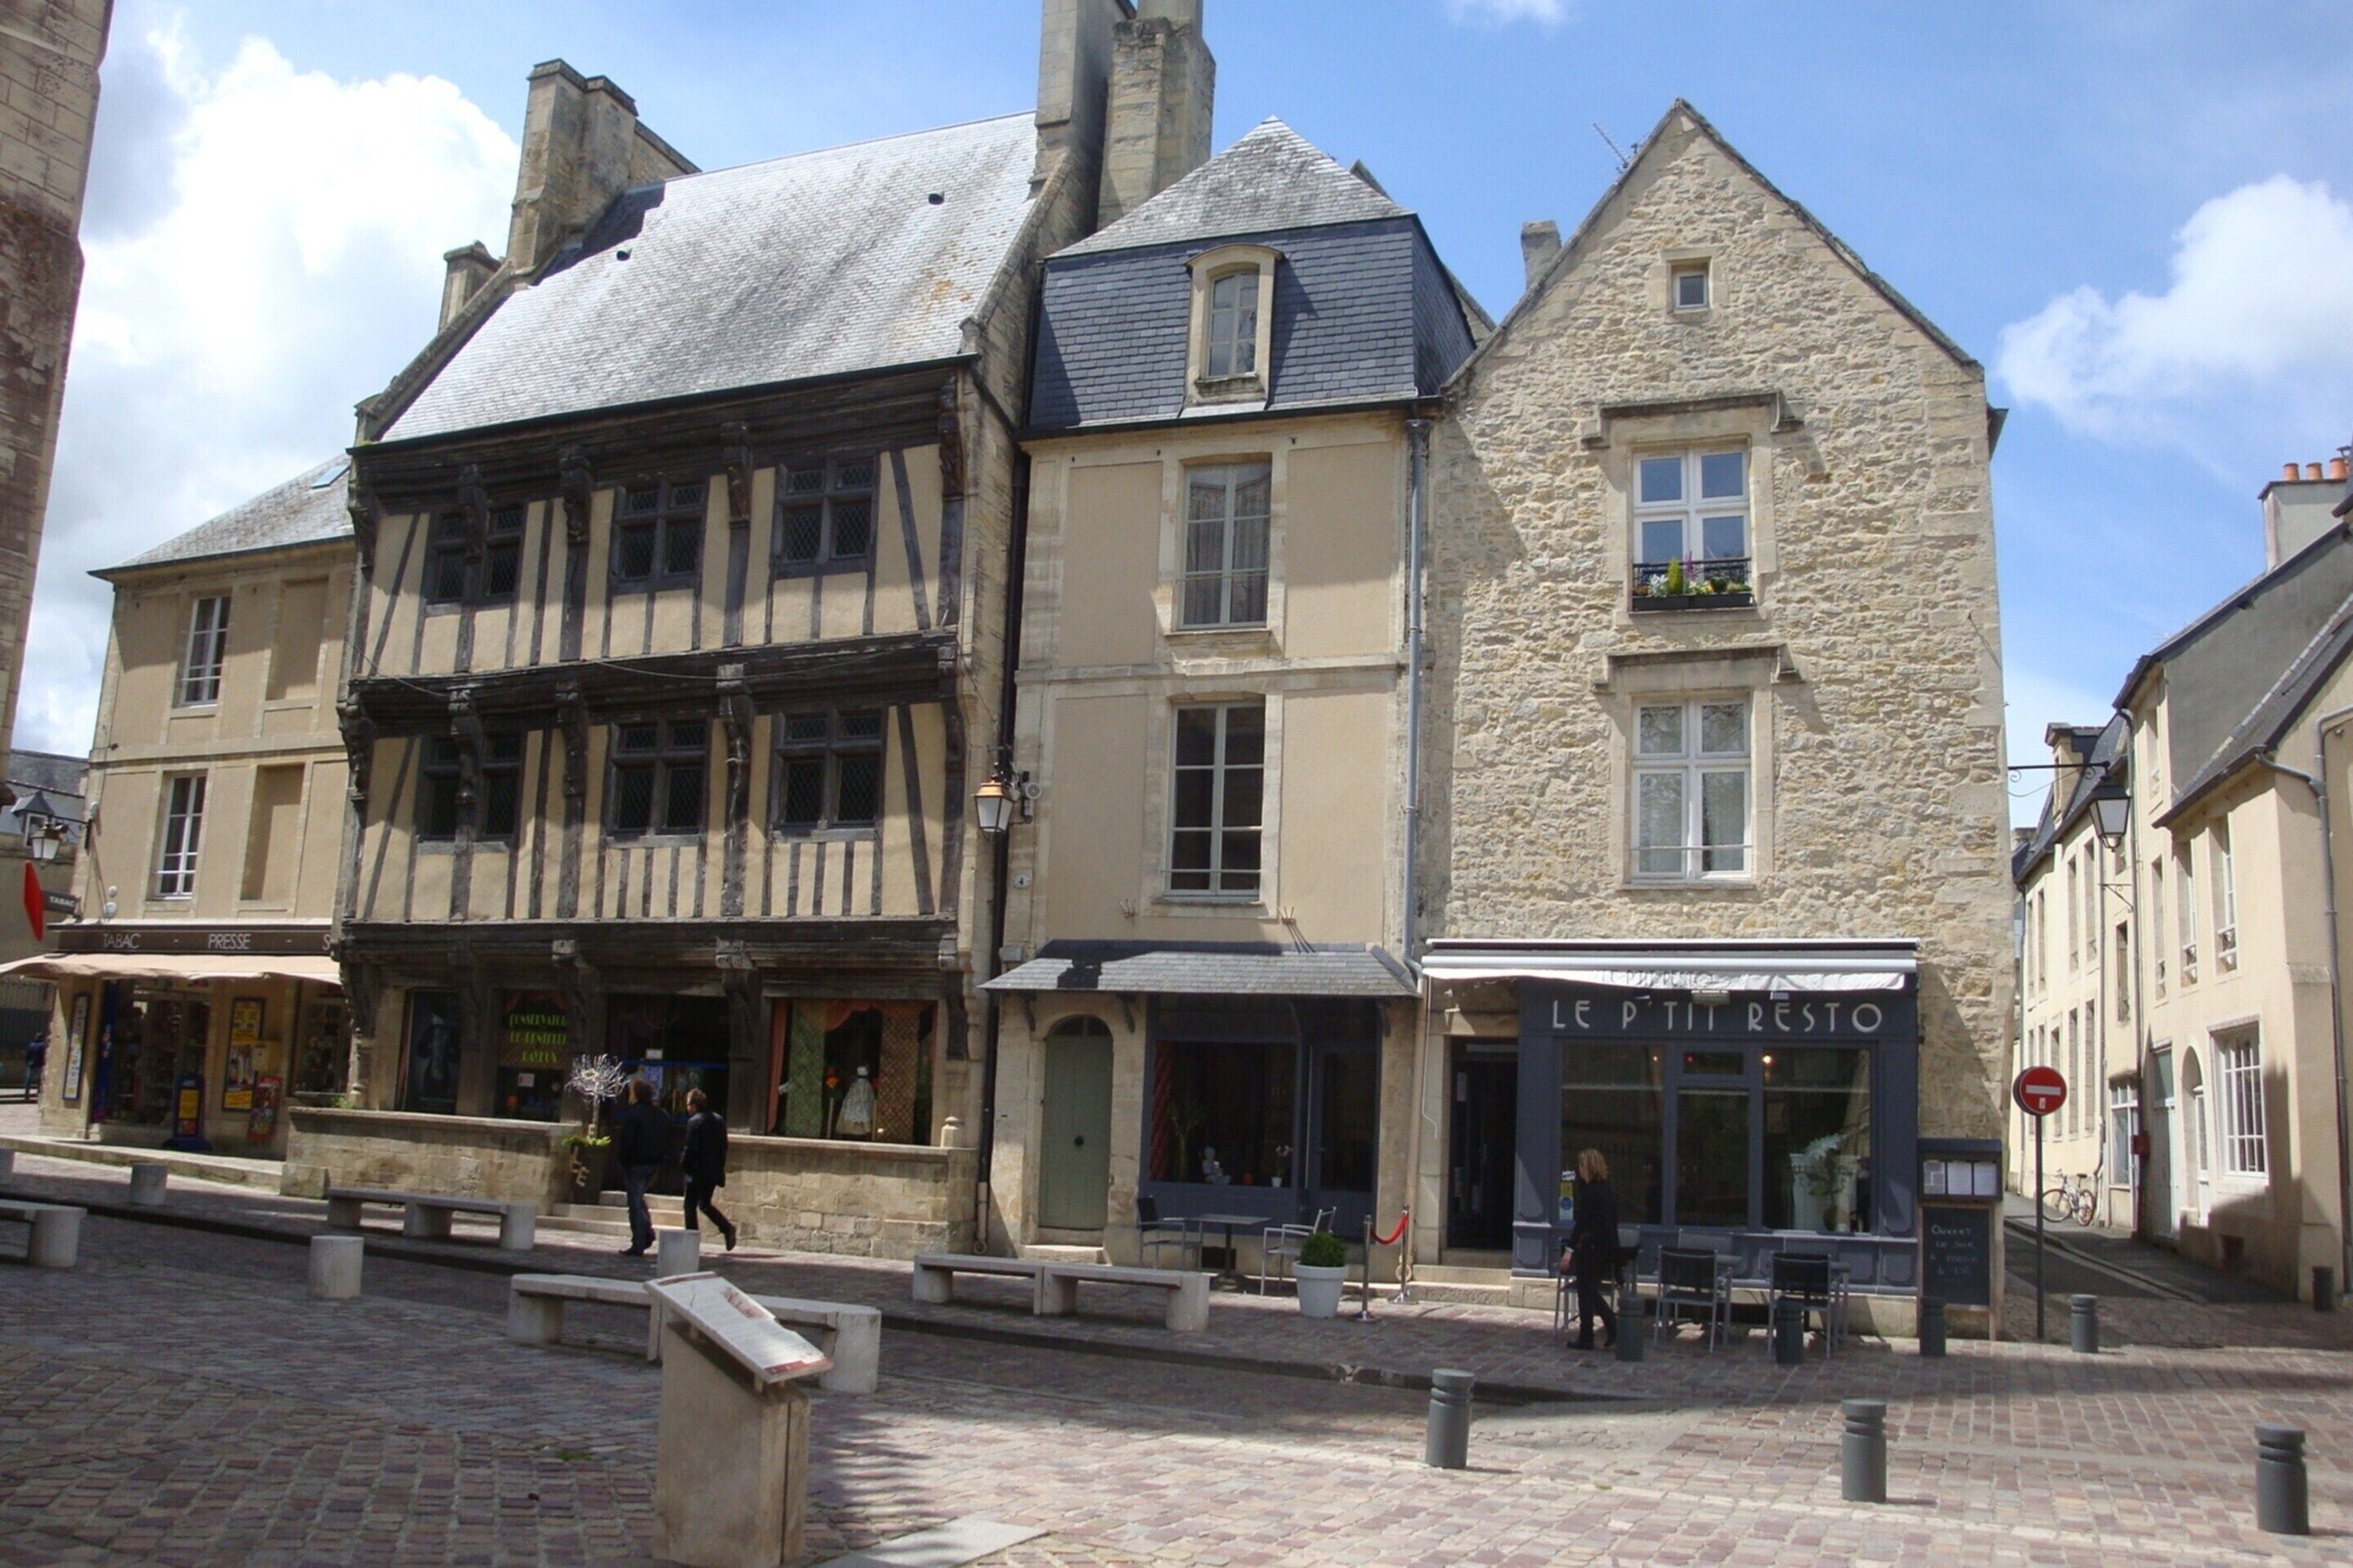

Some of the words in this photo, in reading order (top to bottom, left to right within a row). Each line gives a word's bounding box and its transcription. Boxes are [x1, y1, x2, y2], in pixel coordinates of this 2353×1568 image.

[50, 896, 75, 908] TABAC
[103, 933, 141, 949] TABAC
[208, 933, 250, 950] PRESSE
[1553, 999, 1591, 1029] LE
[1747, 1001, 1882, 1033] RESTO
